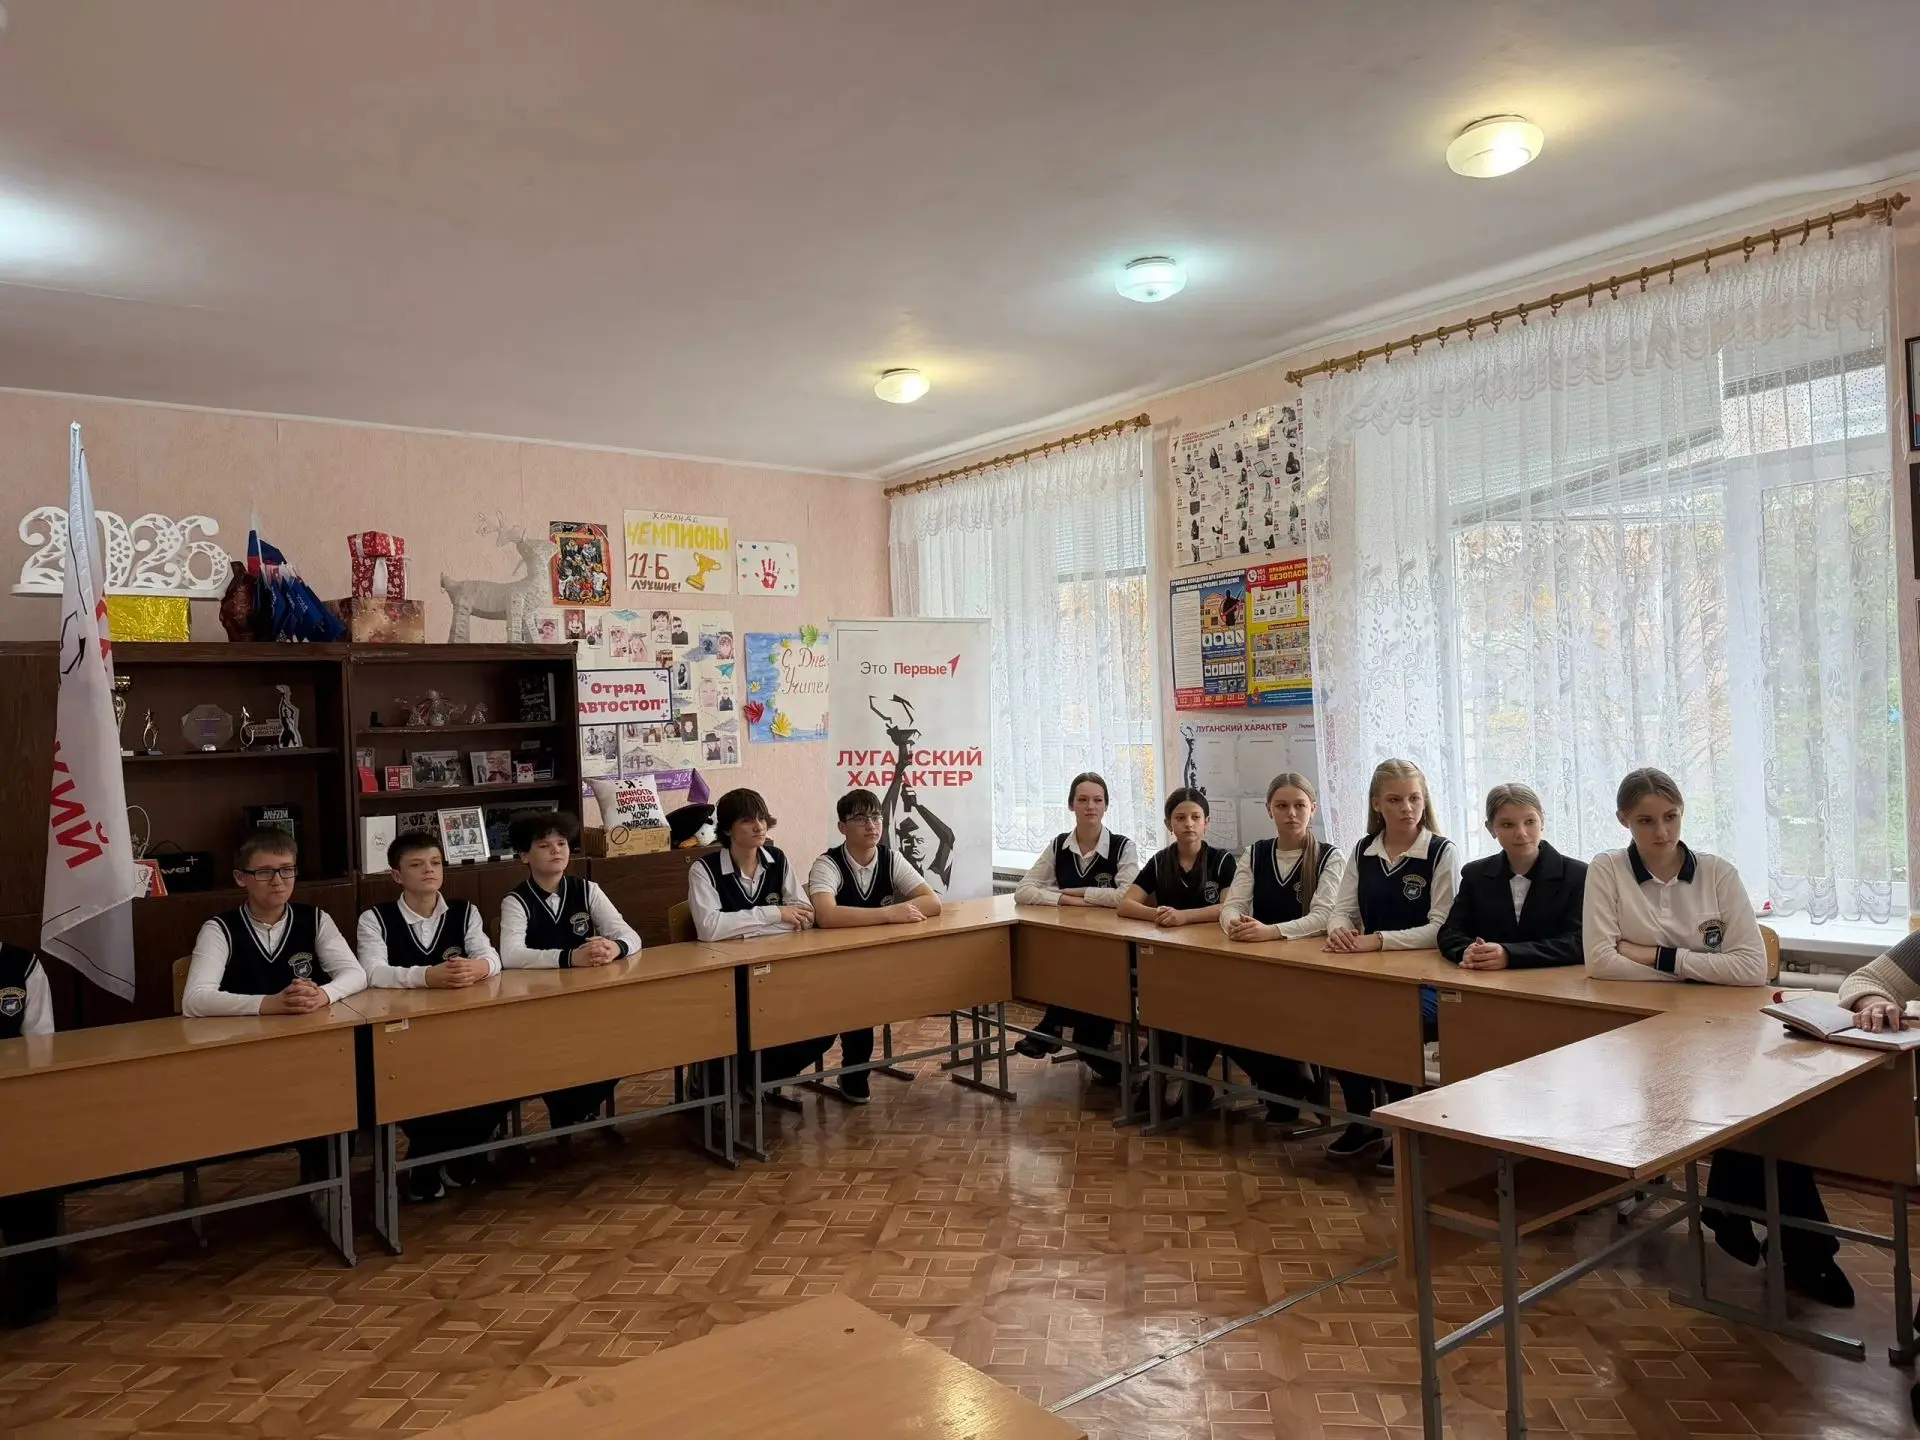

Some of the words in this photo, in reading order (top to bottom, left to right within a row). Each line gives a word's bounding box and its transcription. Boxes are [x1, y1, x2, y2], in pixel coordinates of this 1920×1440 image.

[627, 521, 730, 551] ЧЕМПИОНЫ
[628, 553, 669, 580] 11-Б
[1269, 569, 1309, 581] БЕЗОПАСН
[781, 648, 793, 668] С
[799, 647, 829, 668] Дне
[860, 661, 887, 675] Это
[894, 662, 948, 678] Первые
[591, 683, 646, 697] Отряд
[1196, 722, 1243, 733] ЛУГАНСКИЙ
[1244, 723, 1288, 732] ХАРАКТЕР
[847, 770, 973, 787] ХАРАКТЕР
[616, 788, 653, 799] ЛИЧНОСТЬ
[616, 804, 636, 815] ХОЧУ
[632, 810, 650, 820] ХОЧУ
